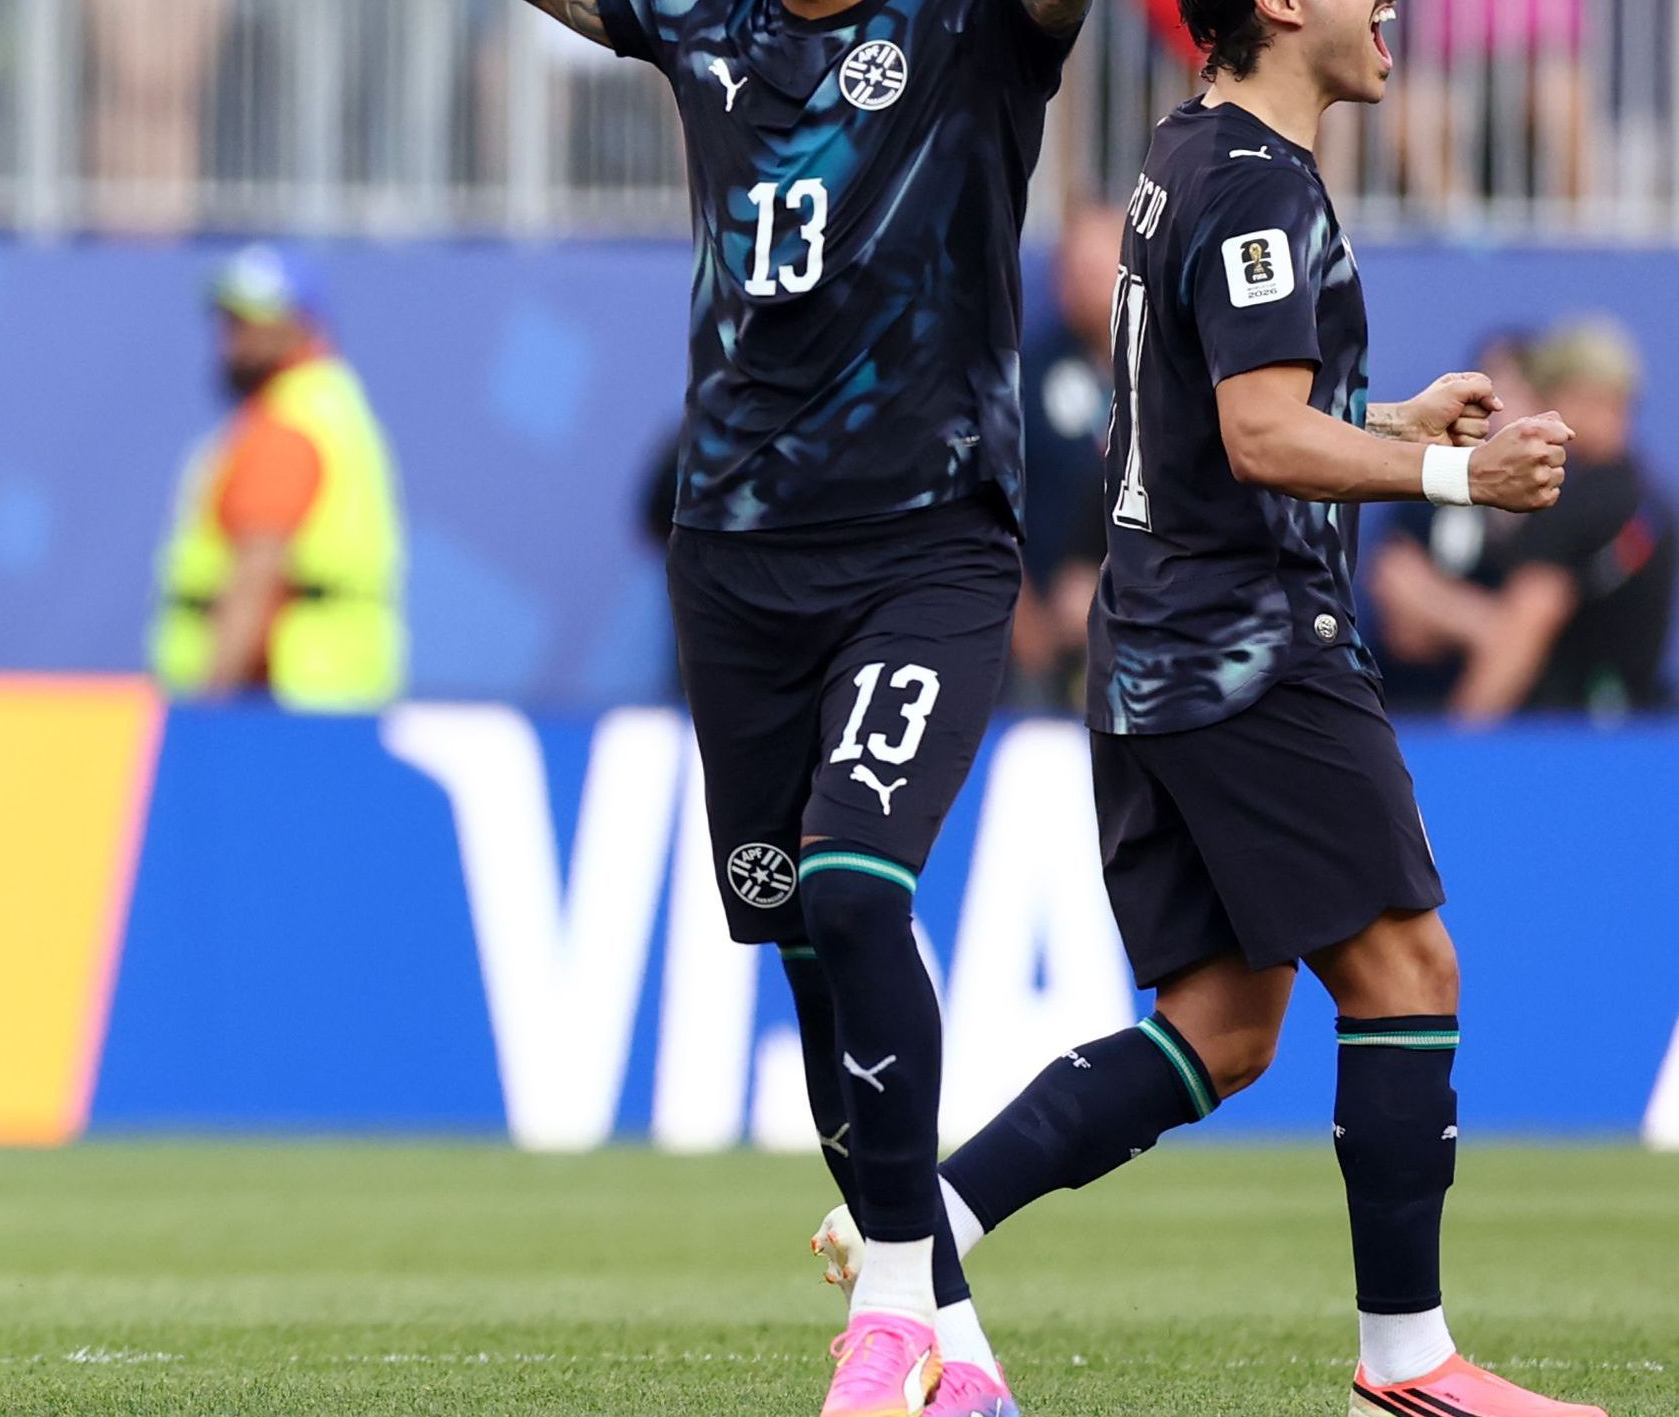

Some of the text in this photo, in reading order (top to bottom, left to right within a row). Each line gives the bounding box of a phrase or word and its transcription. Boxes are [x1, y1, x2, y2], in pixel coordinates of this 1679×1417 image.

[745, 178, 827, 295] 13
[1247, 288, 1278, 299] 2026
[830, 663, 940, 764] 13
[742, 847, 763, 862] APF
